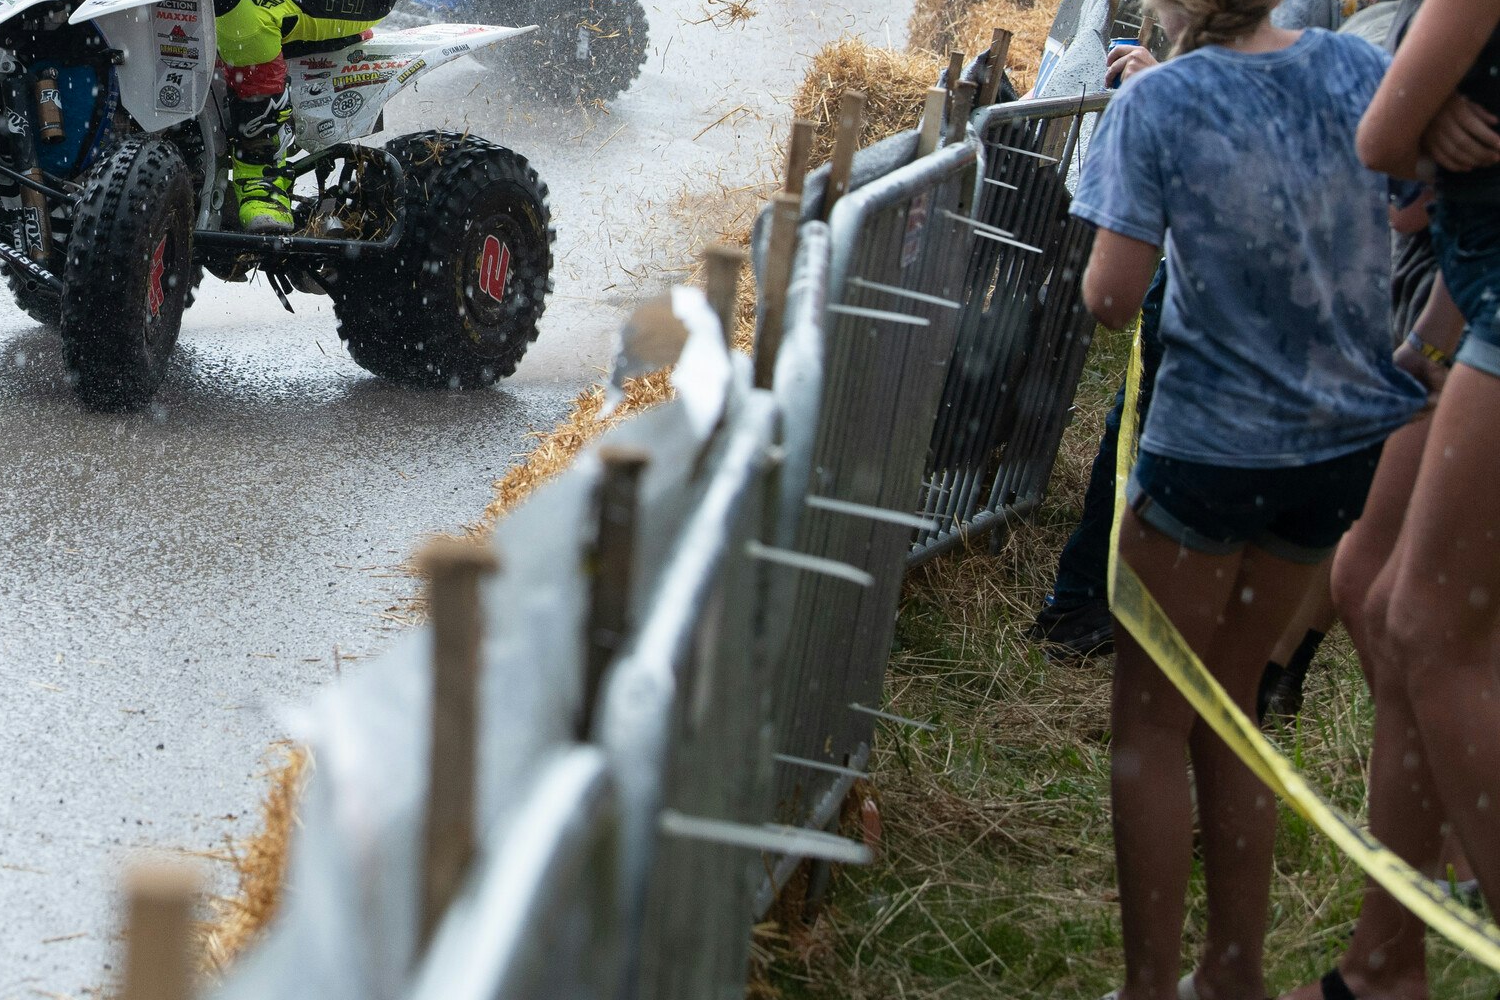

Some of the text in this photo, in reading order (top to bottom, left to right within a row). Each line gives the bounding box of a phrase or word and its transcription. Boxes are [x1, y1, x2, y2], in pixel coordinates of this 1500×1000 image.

[155, 11, 198, 23] MAXXIS
[448, 43, 471, 54] YAMAHA
[332, 71, 380, 87] ITHACA
[23, 206, 45, 252] FOX
